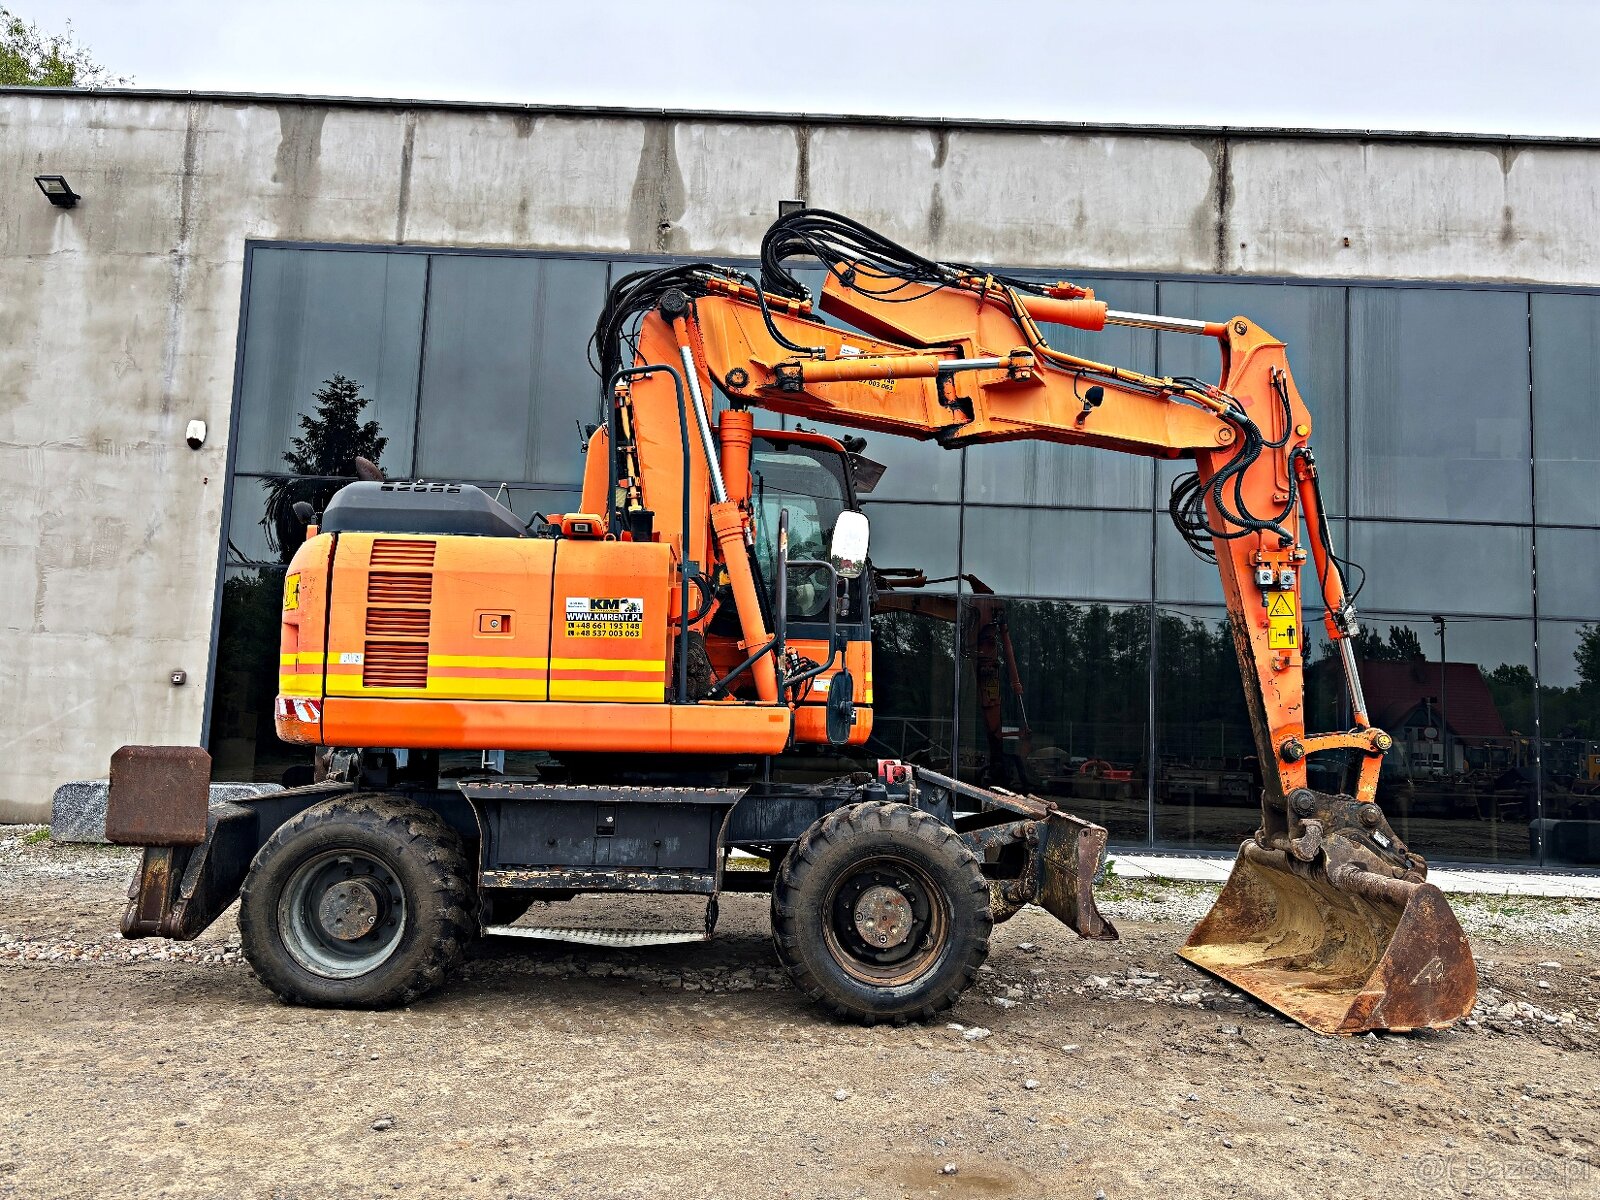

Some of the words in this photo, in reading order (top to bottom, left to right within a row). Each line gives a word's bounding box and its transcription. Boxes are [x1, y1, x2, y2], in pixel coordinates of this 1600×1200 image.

[590, 598, 620, 609] KM
[566, 612, 642, 621] WWW.KMRENT.PL
[609, 622, 623, 630] 195
[576, 629, 590, 637] +48
[592, 629, 606, 637] 537
[608, 629, 623, 637] 003
